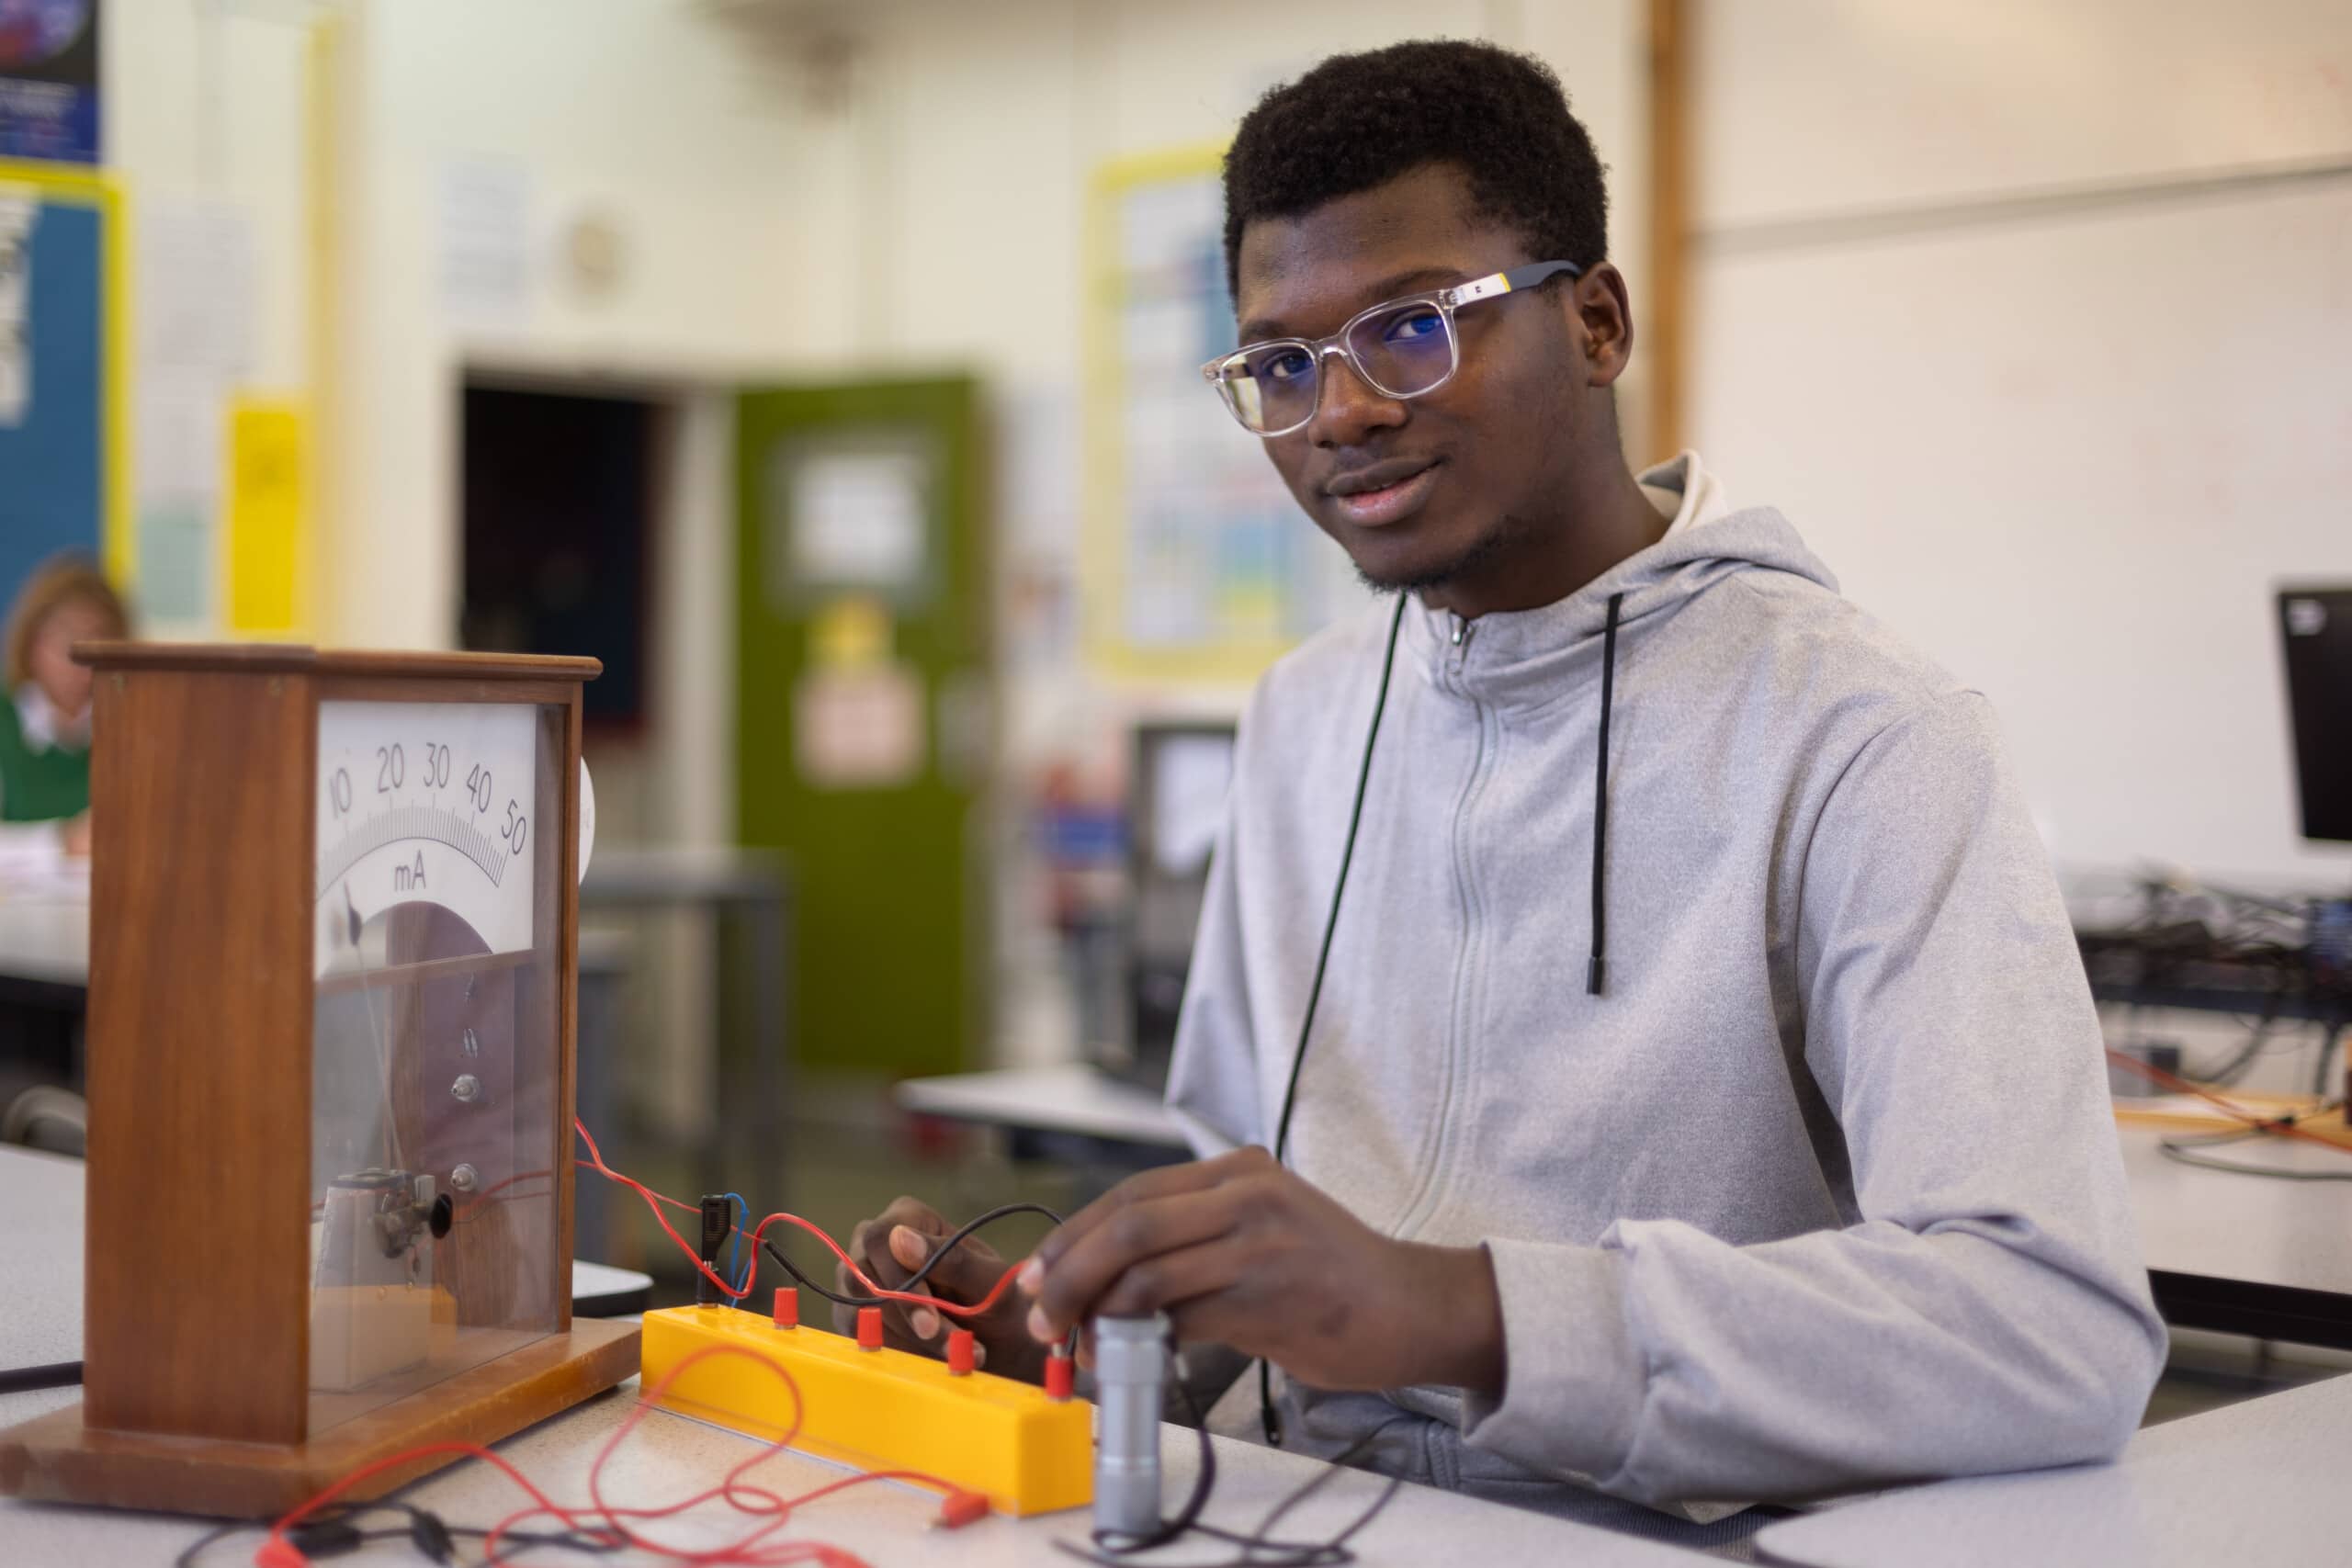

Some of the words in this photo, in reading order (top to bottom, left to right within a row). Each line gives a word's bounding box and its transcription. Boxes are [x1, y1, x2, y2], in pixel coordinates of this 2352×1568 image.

[329, 767, 352, 820] 10
[377, 742, 405, 794] 20
[423, 742, 450, 789] 30
[466, 763, 492, 813] 40
[502, 799, 527, 855] 50
[394, 850, 426, 891] mA
